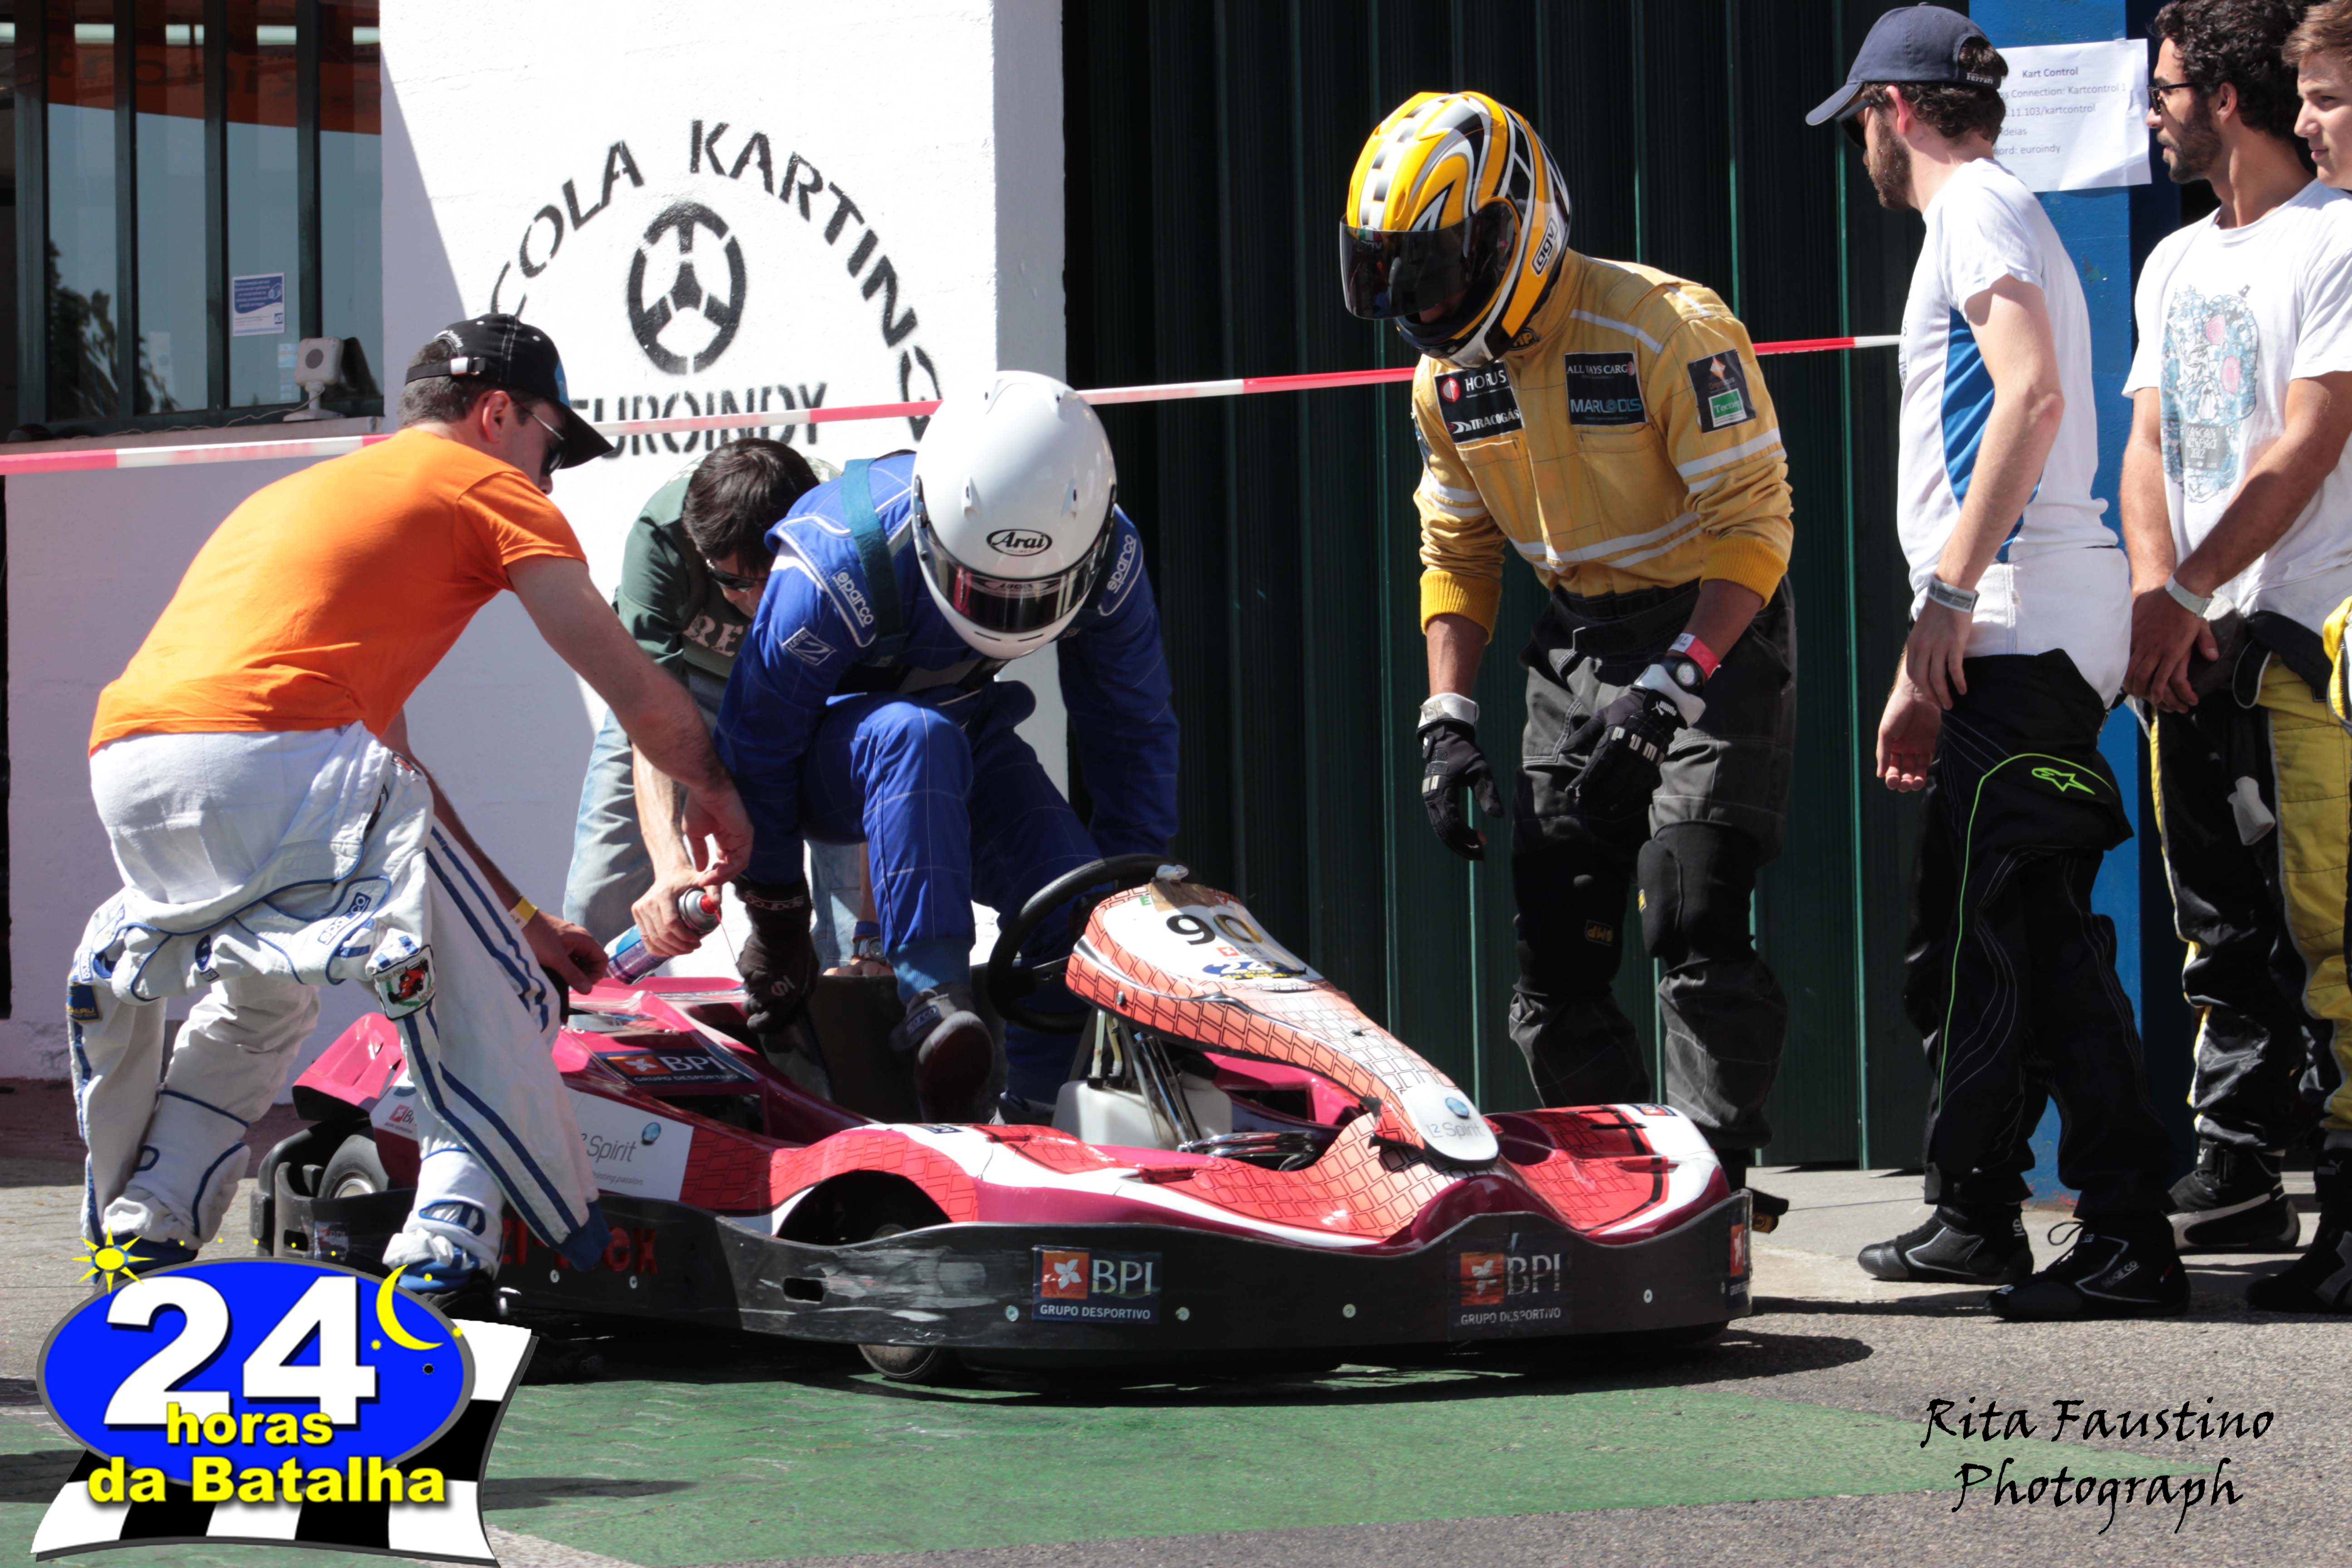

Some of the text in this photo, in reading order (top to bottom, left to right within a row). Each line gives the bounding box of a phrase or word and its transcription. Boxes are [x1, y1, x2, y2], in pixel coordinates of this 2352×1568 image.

[1966, 72, 1994, 84] Ferrari
[2022, 67, 2078, 78] Kart Control
[2011, 87, 2065, 98] Connection:
[2068, 83, 2119, 94] Kartcontrol
[2020, 143, 2061, 153] euroindy
[689, 119, 941, 442] KARTING
[1567, 365, 1584, 374] ALL
[1464, 370, 1507, 392] HORUS
[570, 382, 828, 459] UROINDY
[990, 531, 1045, 549] Arai
[1107, 534, 1137, 594] sparco
[1166, 914, 1264, 946] 90
[658, 1056, 728, 1071] BPI
[1442, 1122, 1485, 1140] Spirit
[587, 1135, 637, 1163] Spirit
[1091, 1259, 1153, 1295] BPI
[1507, 1254, 1561, 1295] BPI
[1039, 1304, 1151, 1320] GRUPO DESPORTIVO
[1460, 1312, 1497, 1326] GRUPO
